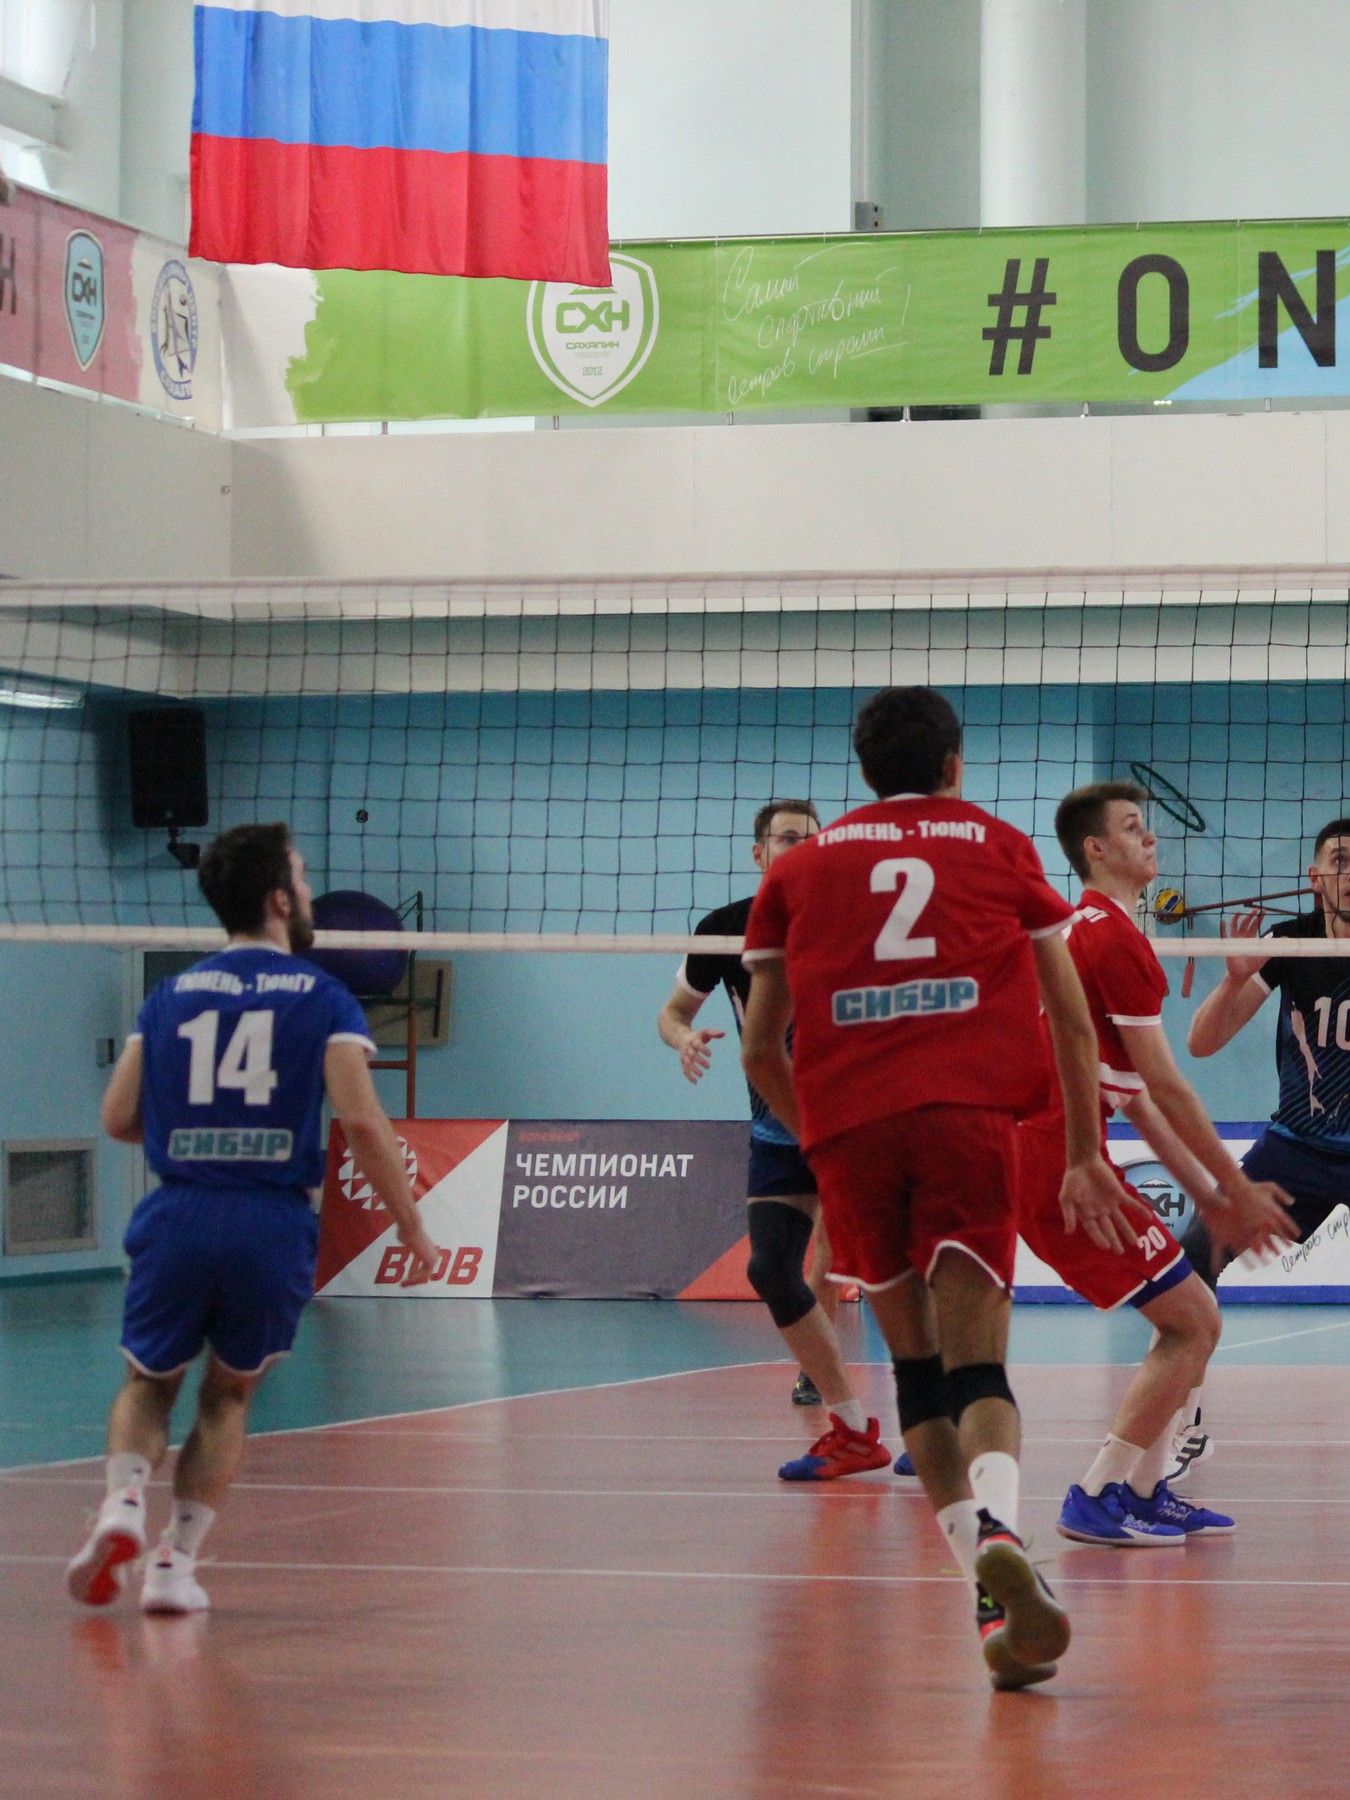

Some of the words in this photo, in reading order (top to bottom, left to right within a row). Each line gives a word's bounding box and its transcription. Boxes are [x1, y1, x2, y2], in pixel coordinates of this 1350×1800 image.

[870, 857, 937, 962] 2
[836, 980, 976, 1022] СИБУР
[177, 1009, 278, 1106] 14
[172, 1132, 290, 1157] СИБУР
[516, 1153, 694, 1177] ЧЕМПИОНАТ
[513, 1185, 628, 1209] РОССИИ
[1137, 1225, 1167, 1262] 20
